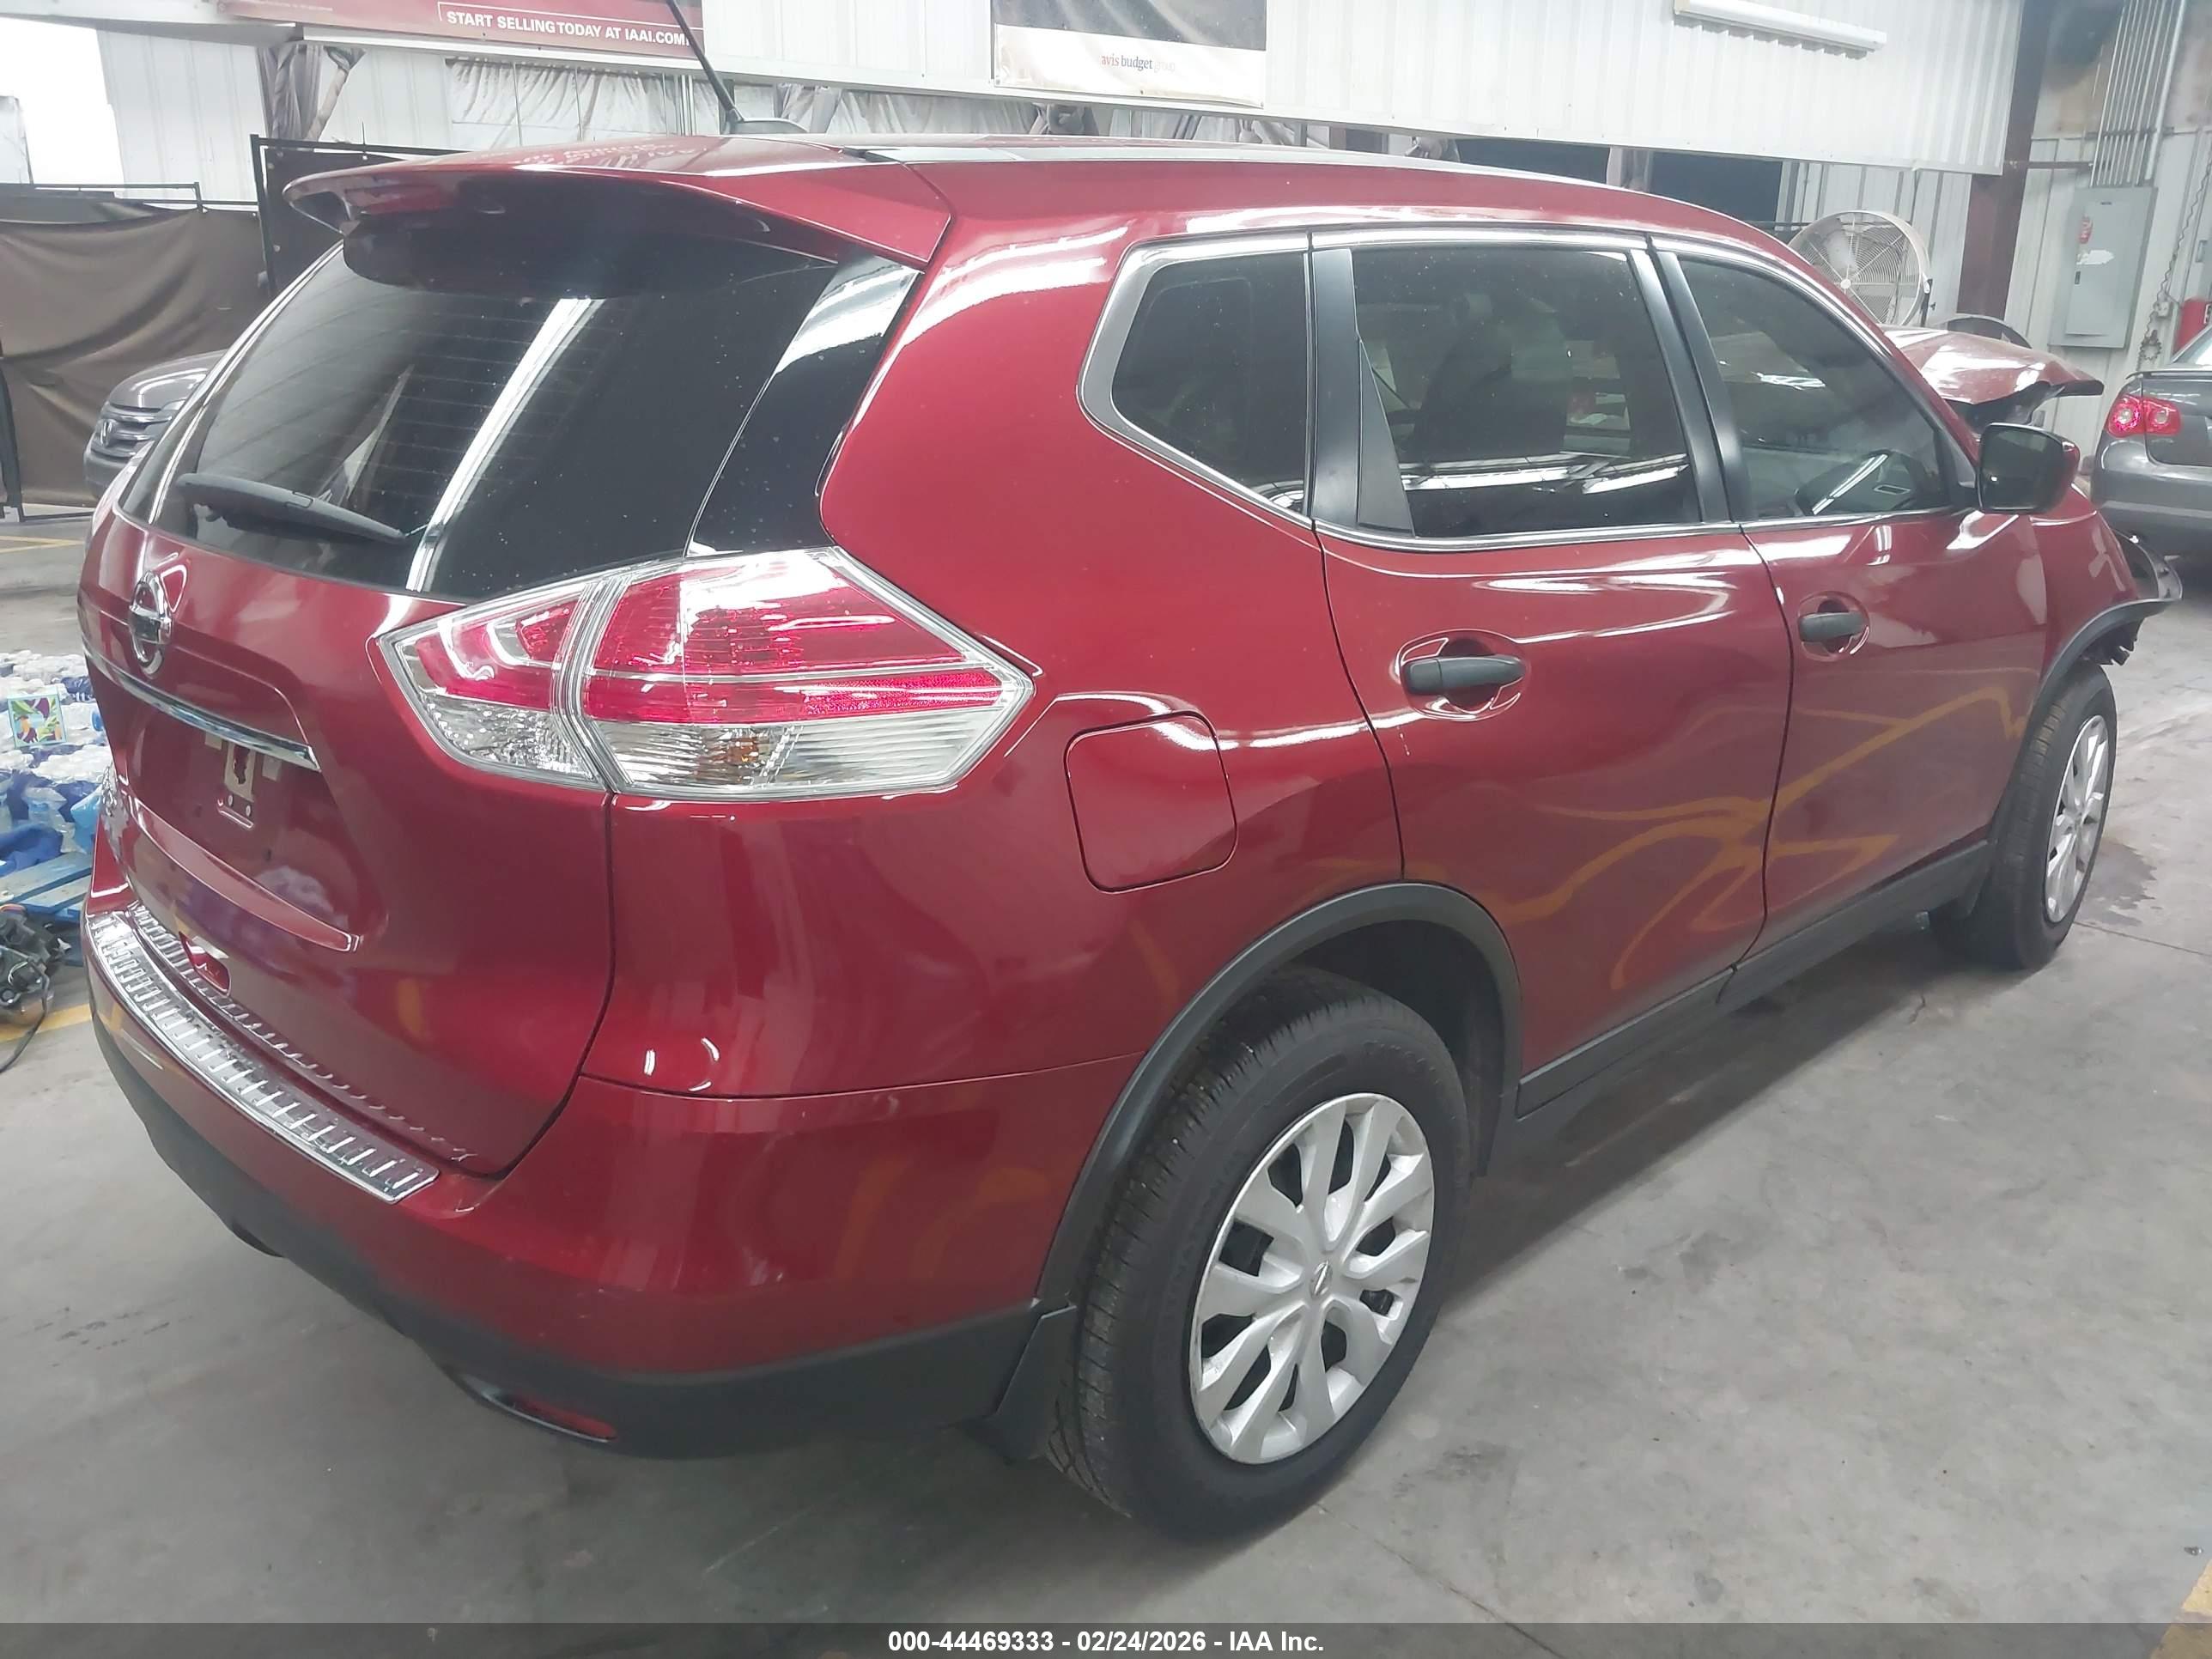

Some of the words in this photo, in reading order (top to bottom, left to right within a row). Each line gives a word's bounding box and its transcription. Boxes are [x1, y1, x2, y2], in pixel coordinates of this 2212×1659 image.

[446, 11, 495, 27] START
[496, 16, 556, 33] SELLING
[557, 21, 602, 38] TODAY
[605, 27, 622, 40] AT
[1101, 53, 1120, 67] avis
[1121, 55, 1153, 71] budget
